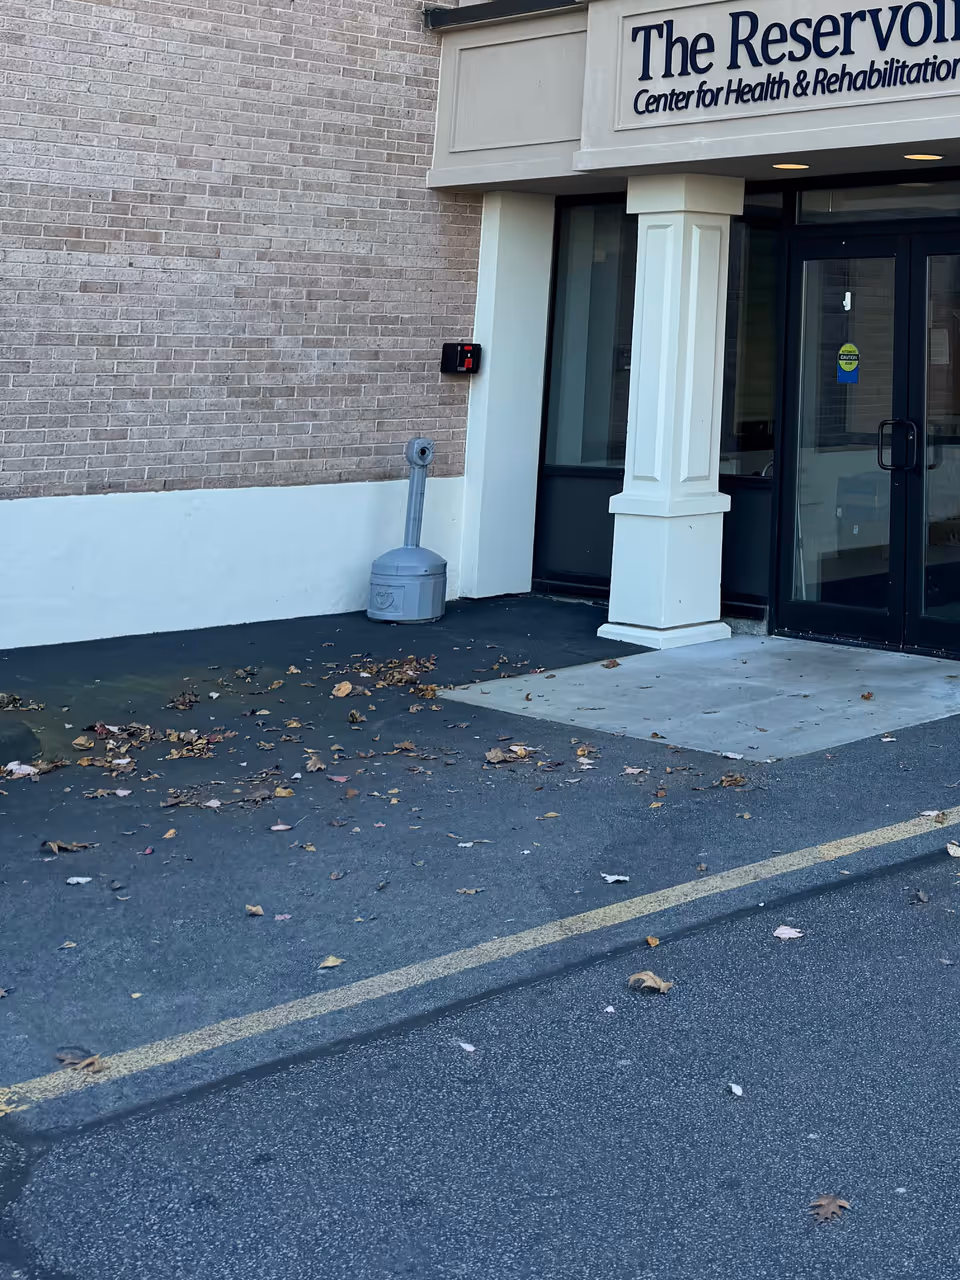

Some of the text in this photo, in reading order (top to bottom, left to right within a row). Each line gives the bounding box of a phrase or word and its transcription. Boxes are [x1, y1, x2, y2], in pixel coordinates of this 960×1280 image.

[632, 19, 715, 81] The
[634, 88, 696, 115] Center
[696, 81, 724, 108] for
[725, 71, 790, 105] Health
[793, 70, 810, 97] &
